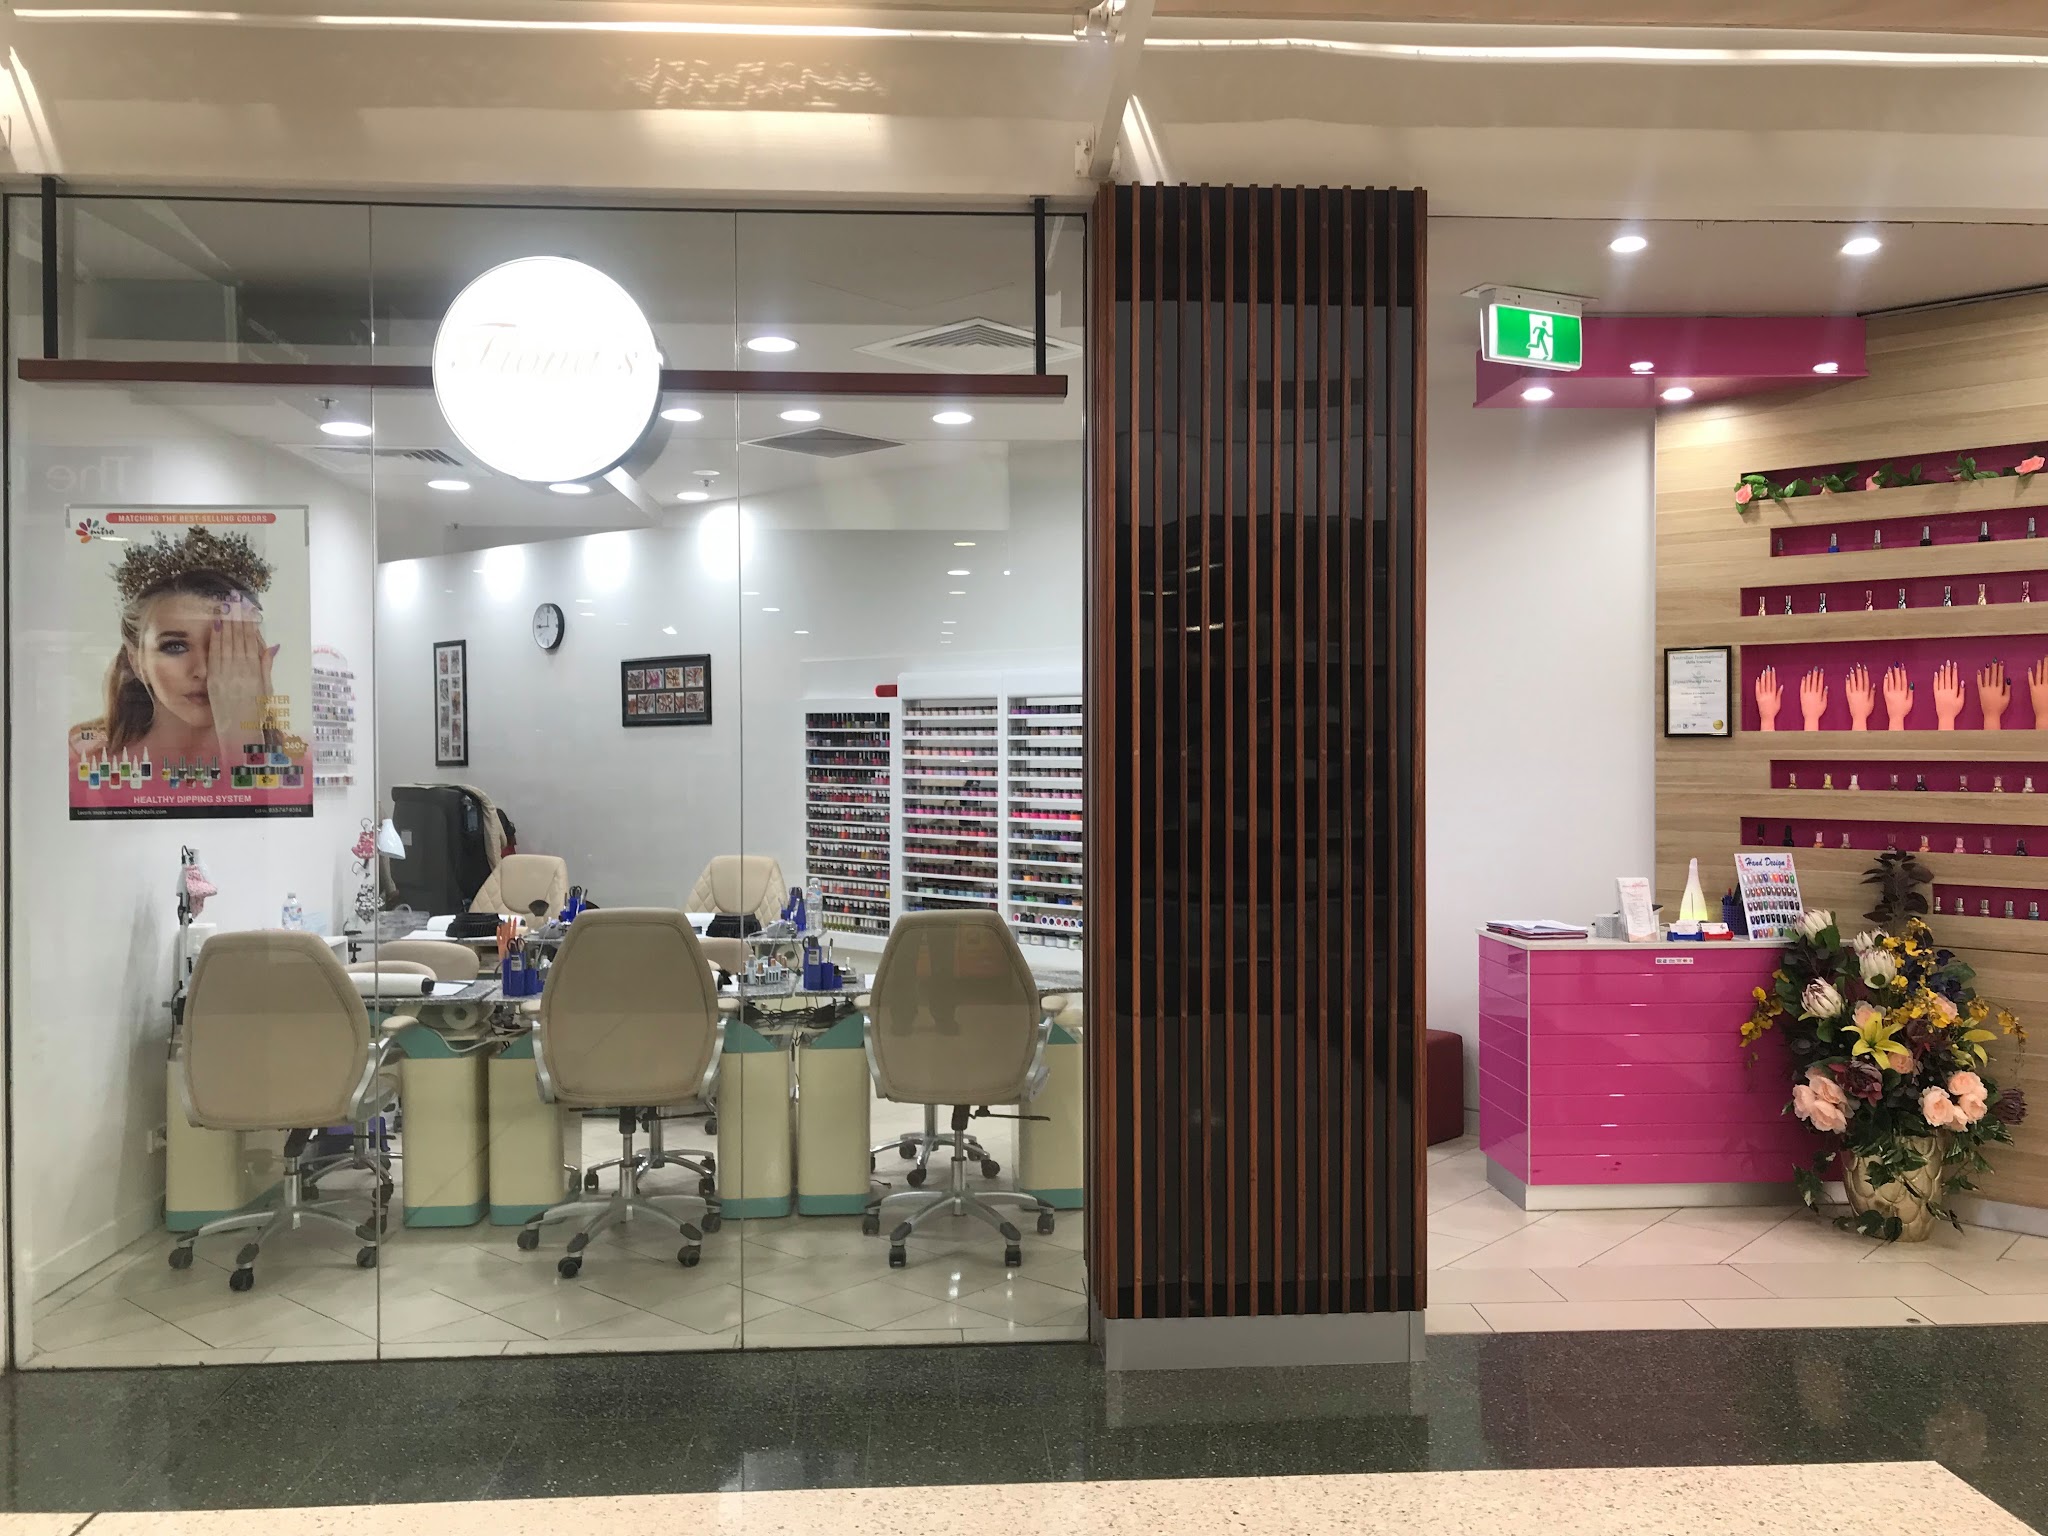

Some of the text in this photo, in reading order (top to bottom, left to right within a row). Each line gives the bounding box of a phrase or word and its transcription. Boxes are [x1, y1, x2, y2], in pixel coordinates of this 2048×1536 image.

[133, 794, 252, 804] HEALTHY DIPPING SYSTEM
[1745, 857, 1785, 868] Hand Design
